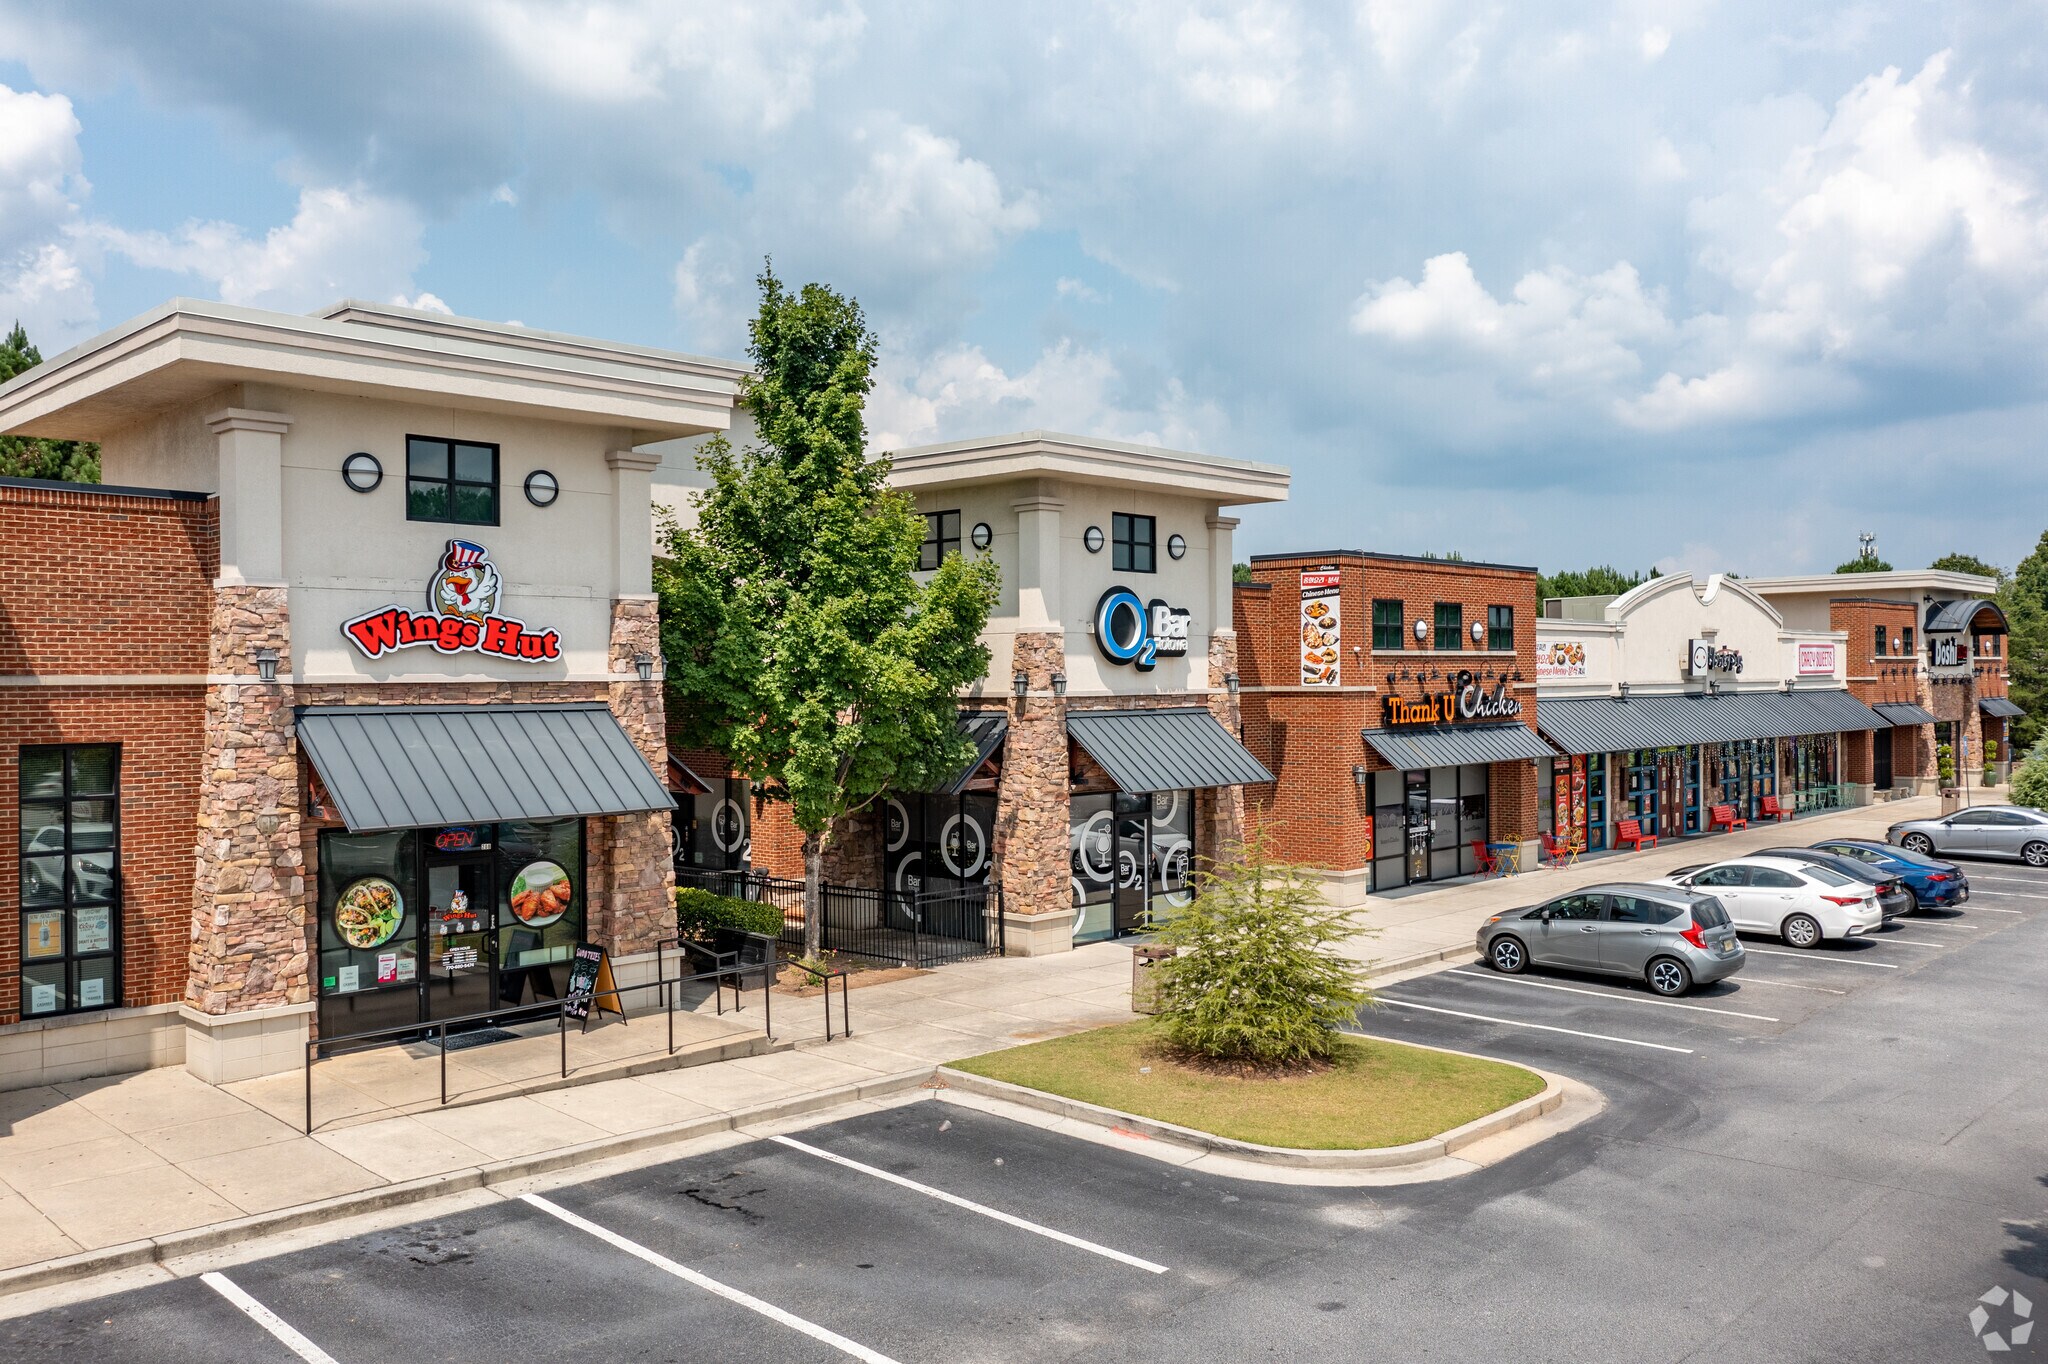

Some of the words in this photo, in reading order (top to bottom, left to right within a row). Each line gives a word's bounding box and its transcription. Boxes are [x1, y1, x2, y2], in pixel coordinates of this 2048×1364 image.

[1153, 606, 1192, 637] Bar
[349, 608, 480, 656] Wings
[482, 616, 560, 659] Hut
[1801, 651, 1816, 667] CRAZY
[1816, 651, 1832, 667] SWEETS
[1935, 638, 1958, 666] Doshi
[1389, 695, 1440, 724] Thank
[1443, 695, 1456, 721] U
[1460, 685, 1522, 718] Chicken
[1156, 794, 1169, 805] Bar
[891, 818, 901, 828] Bar
[435, 831, 475, 849] OPEN
[966, 840, 977, 849] Bar
[1120, 863, 1131, 872] Bar
[907, 874, 921, 887] Bar
